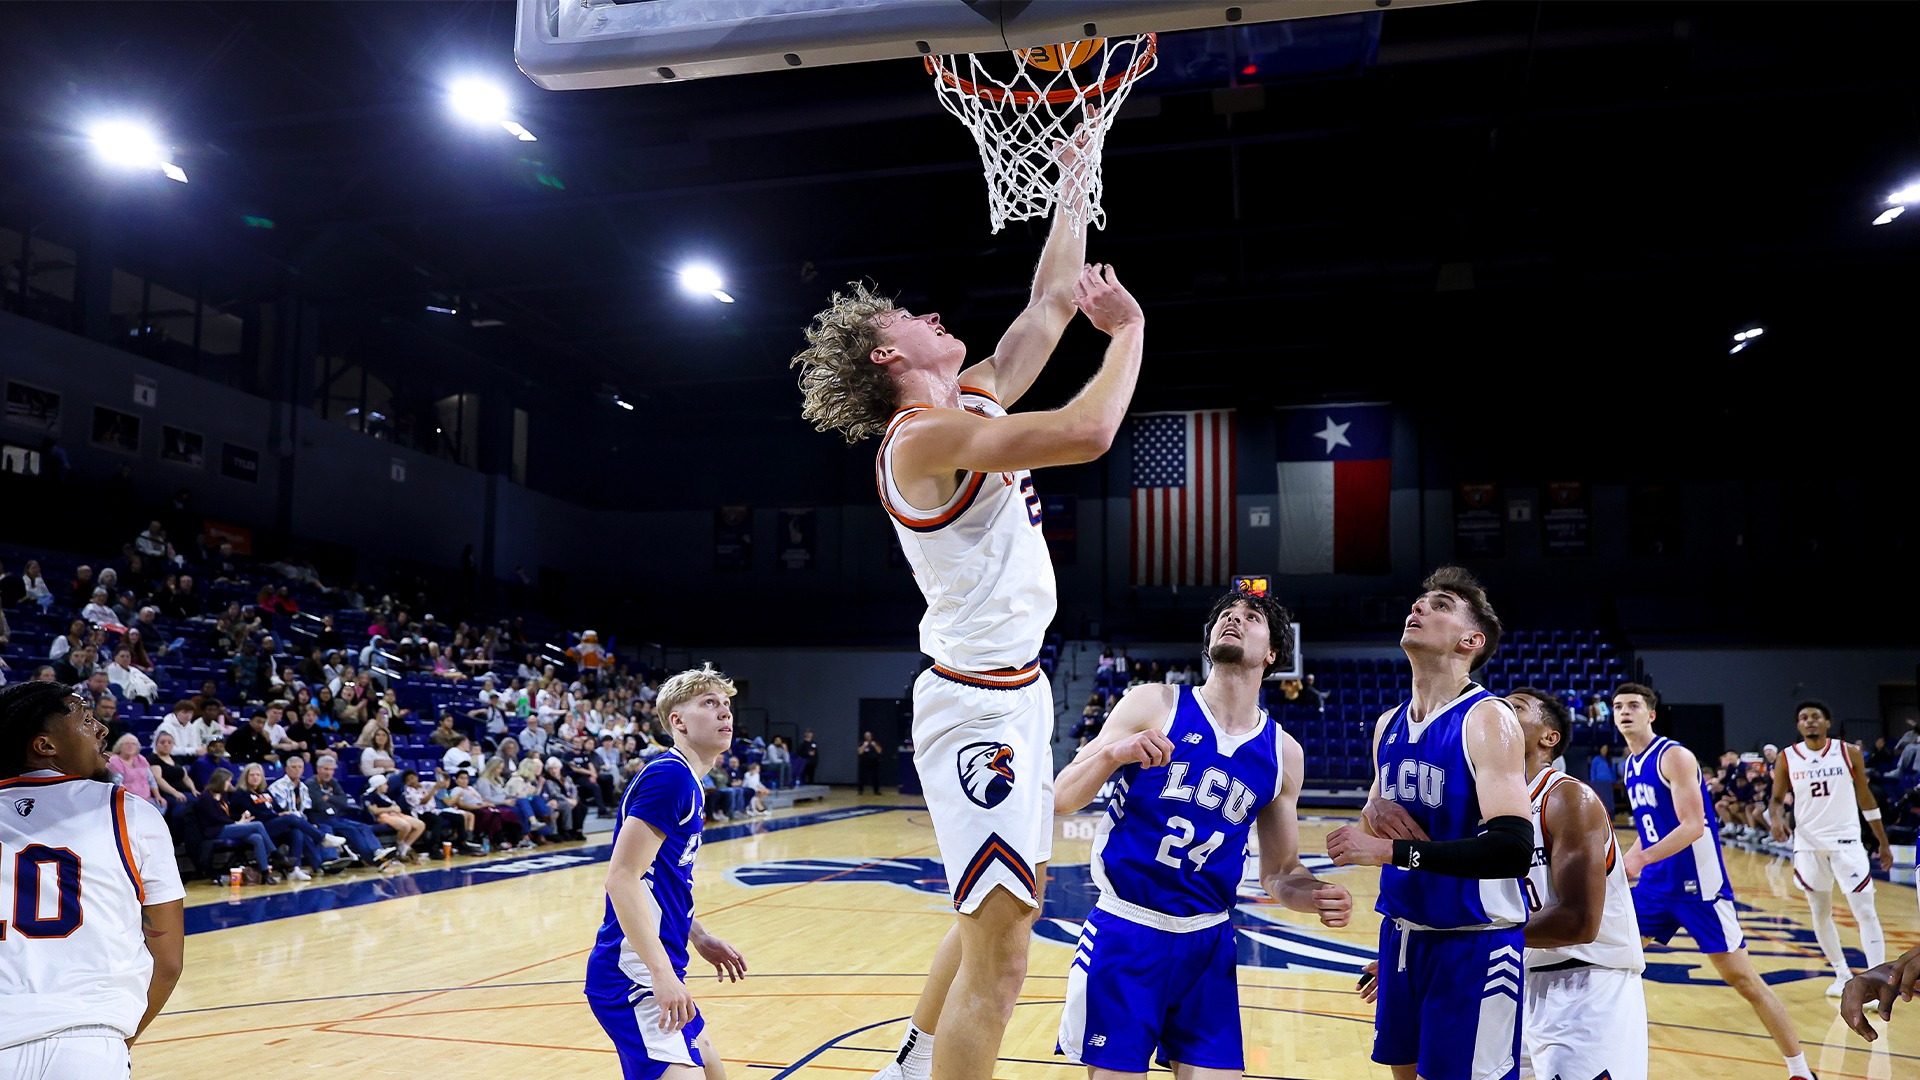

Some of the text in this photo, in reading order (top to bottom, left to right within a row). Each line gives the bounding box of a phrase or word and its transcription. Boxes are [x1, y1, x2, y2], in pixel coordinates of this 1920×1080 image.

[1380, 758, 1445, 809] LCU
[1808, 766, 1843, 779] TYLER
[1810, 781, 1831, 798] 21
[1158, 762, 1257, 826] LCU
[1627, 782, 1658, 810] LCU
[1155, 815, 1225, 872] 24
[1641, 813, 1659, 843] 8
[0, 842, 84, 940] 0
